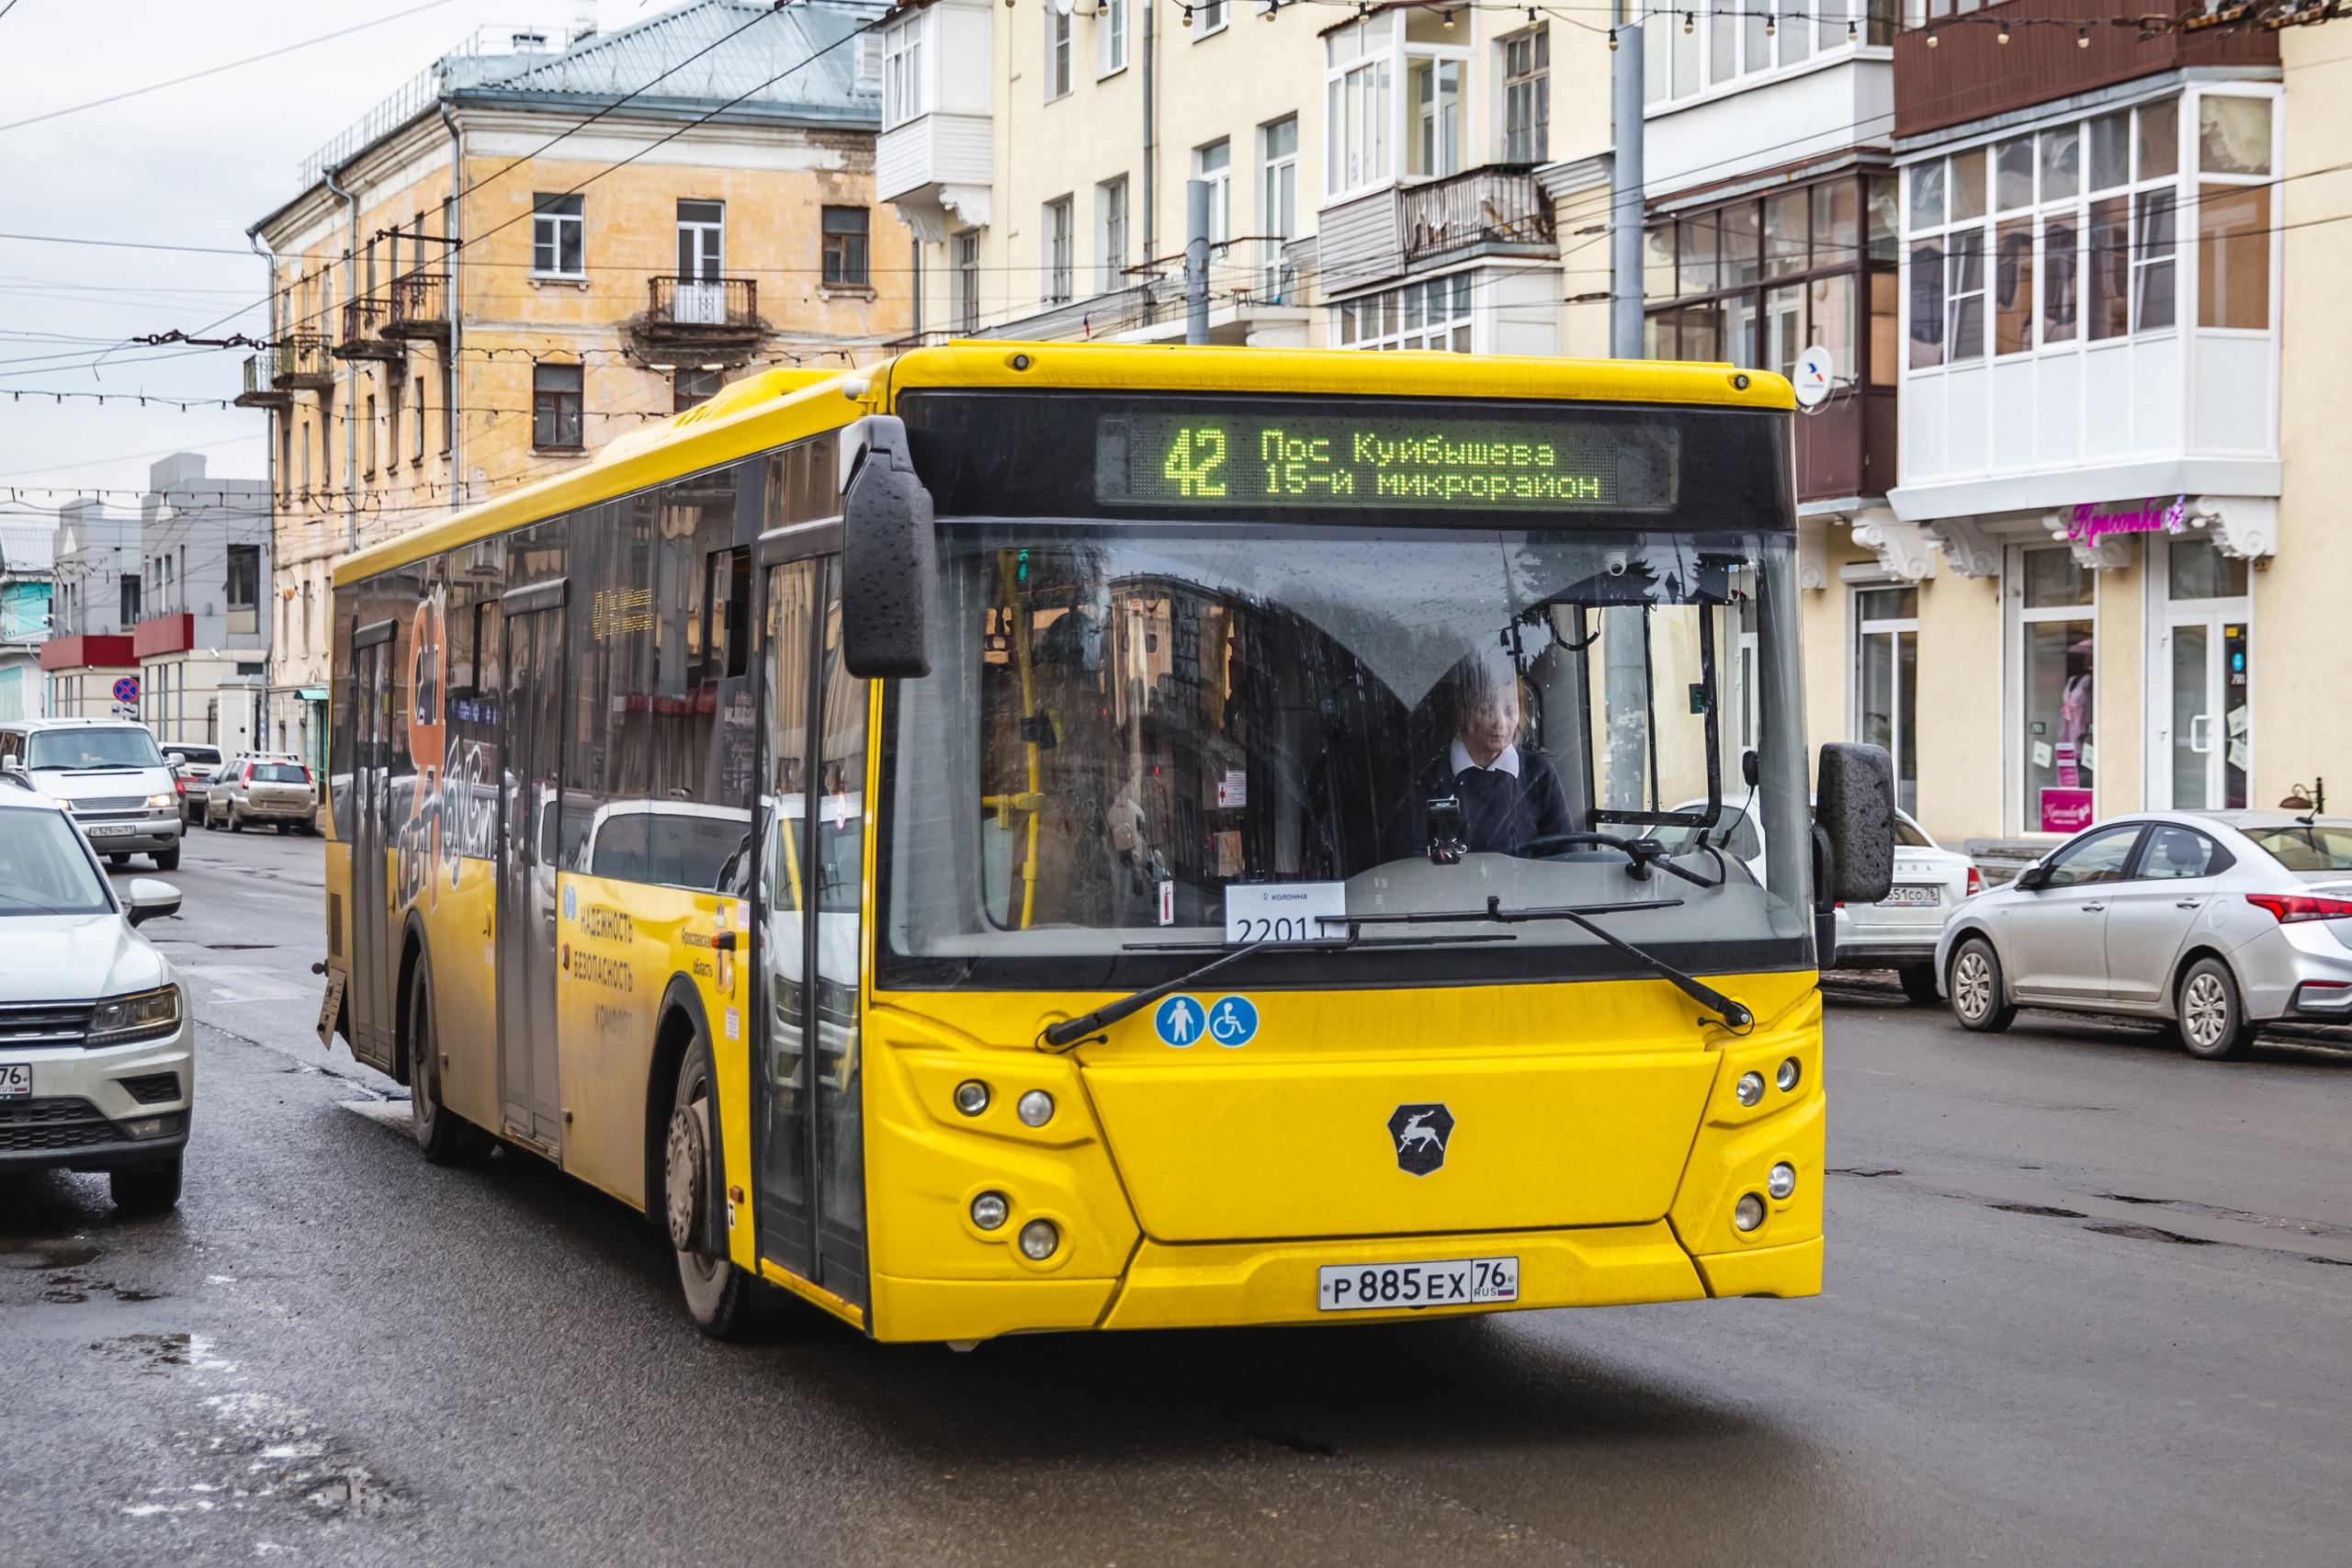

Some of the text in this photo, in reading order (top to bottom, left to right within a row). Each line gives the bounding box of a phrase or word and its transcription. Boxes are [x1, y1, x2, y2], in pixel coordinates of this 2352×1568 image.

[1164, 429, 1226, 496] 42
[1261, 430, 1555, 467] Пос Куйбышева
[1266, 463, 1599, 501] 15-й микрорайон
[1272, 892, 1307, 901] колонна
[573, 950, 633, 993] БЕЗОПАСНОСТЬ
[0, 1067, 21, 1086] 76
[0, 1085, 14, 1093] US
[1334, 1262, 1507, 1304] Р885ЕХ 76
[1475, 1286, 1497, 1297] RUS
